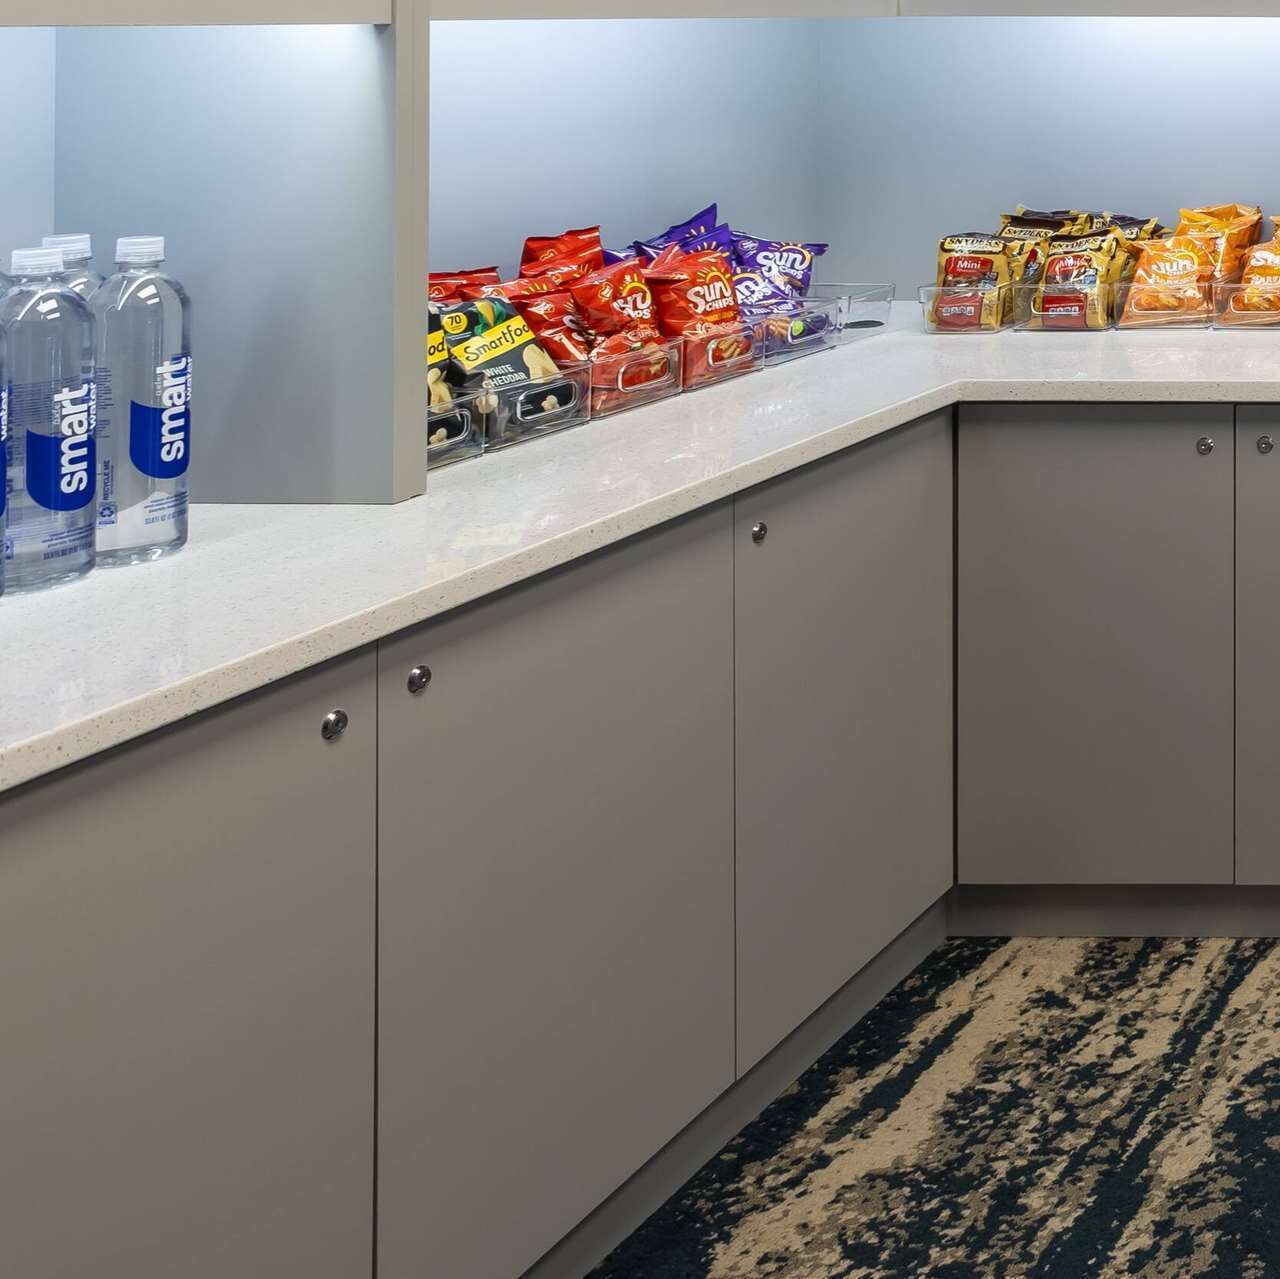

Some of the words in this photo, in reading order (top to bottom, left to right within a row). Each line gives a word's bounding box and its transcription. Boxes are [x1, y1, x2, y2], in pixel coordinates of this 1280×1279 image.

[757, 250, 809, 277] Sun
[957, 260, 981, 269] Mini
[687, 279, 732, 314] Sun
[705, 297, 735, 312] CHIPS
[447, 313, 462, 327] 70
[482, 363, 514, 378] WHITE
[482, 372, 528, 390] CHEDDAR
[155, 357, 187, 463] smart
[53, 383, 89, 494] smart
